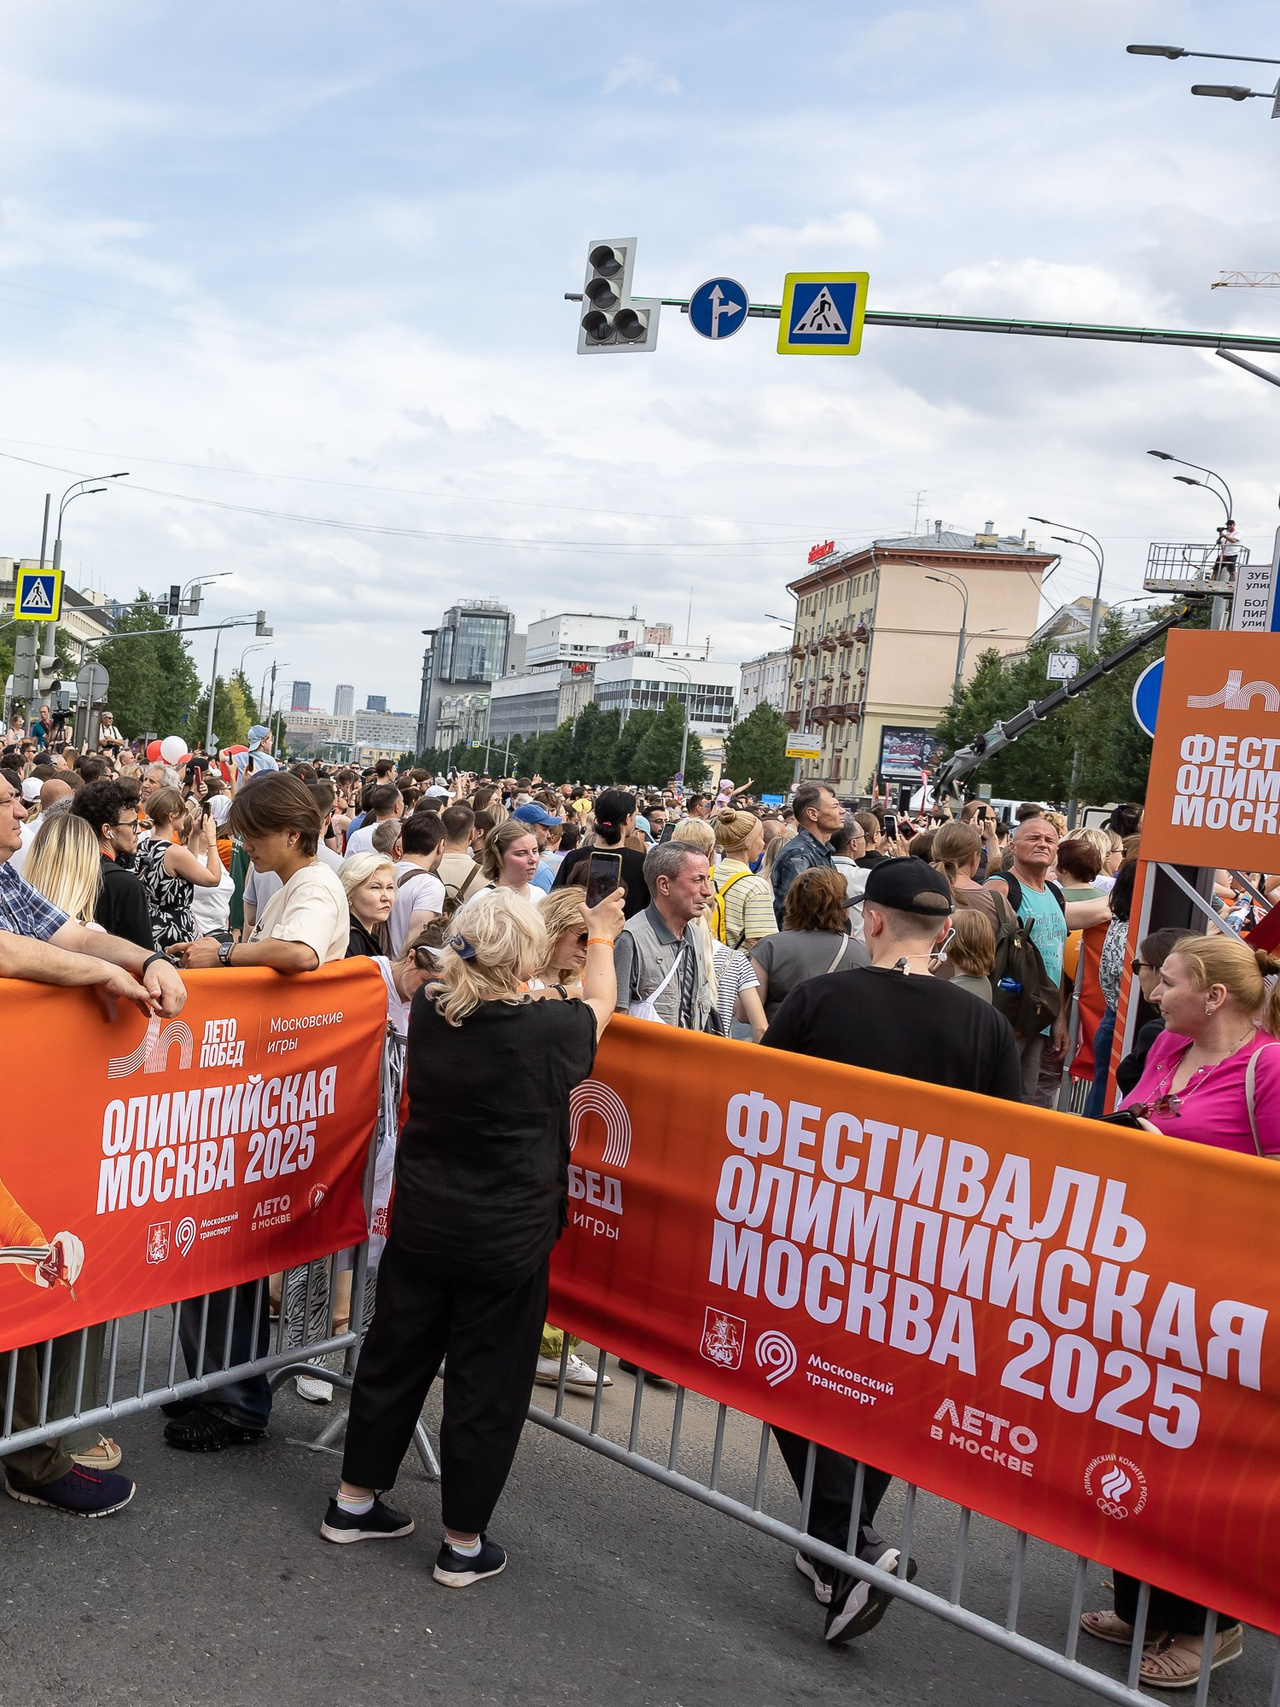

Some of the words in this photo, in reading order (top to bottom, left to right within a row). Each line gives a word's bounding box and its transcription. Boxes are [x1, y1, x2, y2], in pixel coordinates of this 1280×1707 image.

[1171, 795, 1280, 835] МОСК
[202, 1017, 238, 1045] ЛЕТО
[270, 1010, 344, 1034] Московские
[199, 1040, 246, 1068] ПОБЕД
[267, 1035, 299, 1056] игры
[101, 1065, 338, 1157] ОЛИМПИЙСКАЯ
[96, 1136, 235, 1216] МОСКВА
[243, 1120, 318, 1185] 2025
[725, 1090, 1148, 1264] ФЕСТИВАЛЬ
[200, 1211, 239, 1229] Московский
[253, 1194, 291, 1219] ЛЕТО
[200, 1225, 231, 1241] транспорт
[251, 1222, 257, 1231] В
[258, 1213, 292, 1229] МОСКВЕ
[573, 1211, 619, 1240] игры
[714, 1154, 1269, 1391] ОЛИМПИЙСКАЯ
[708, 1217, 977, 1377] МОСКВА
[1000, 1317, 1202, 1450] 2025
[806, 1371, 877, 1406] транспорт
[807, 1353, 895, 1396] Московский
[933, 1398, 1038, 1455] ЛЕТО
[930, 1424, 944, 1441] В
[949, 1431, 1034, 1477] МОСКВЕ
[1118, 1456, 1147, 1484] КОМИТЕТ
[1132, 1486, 1148, 1516] РОССИИ
